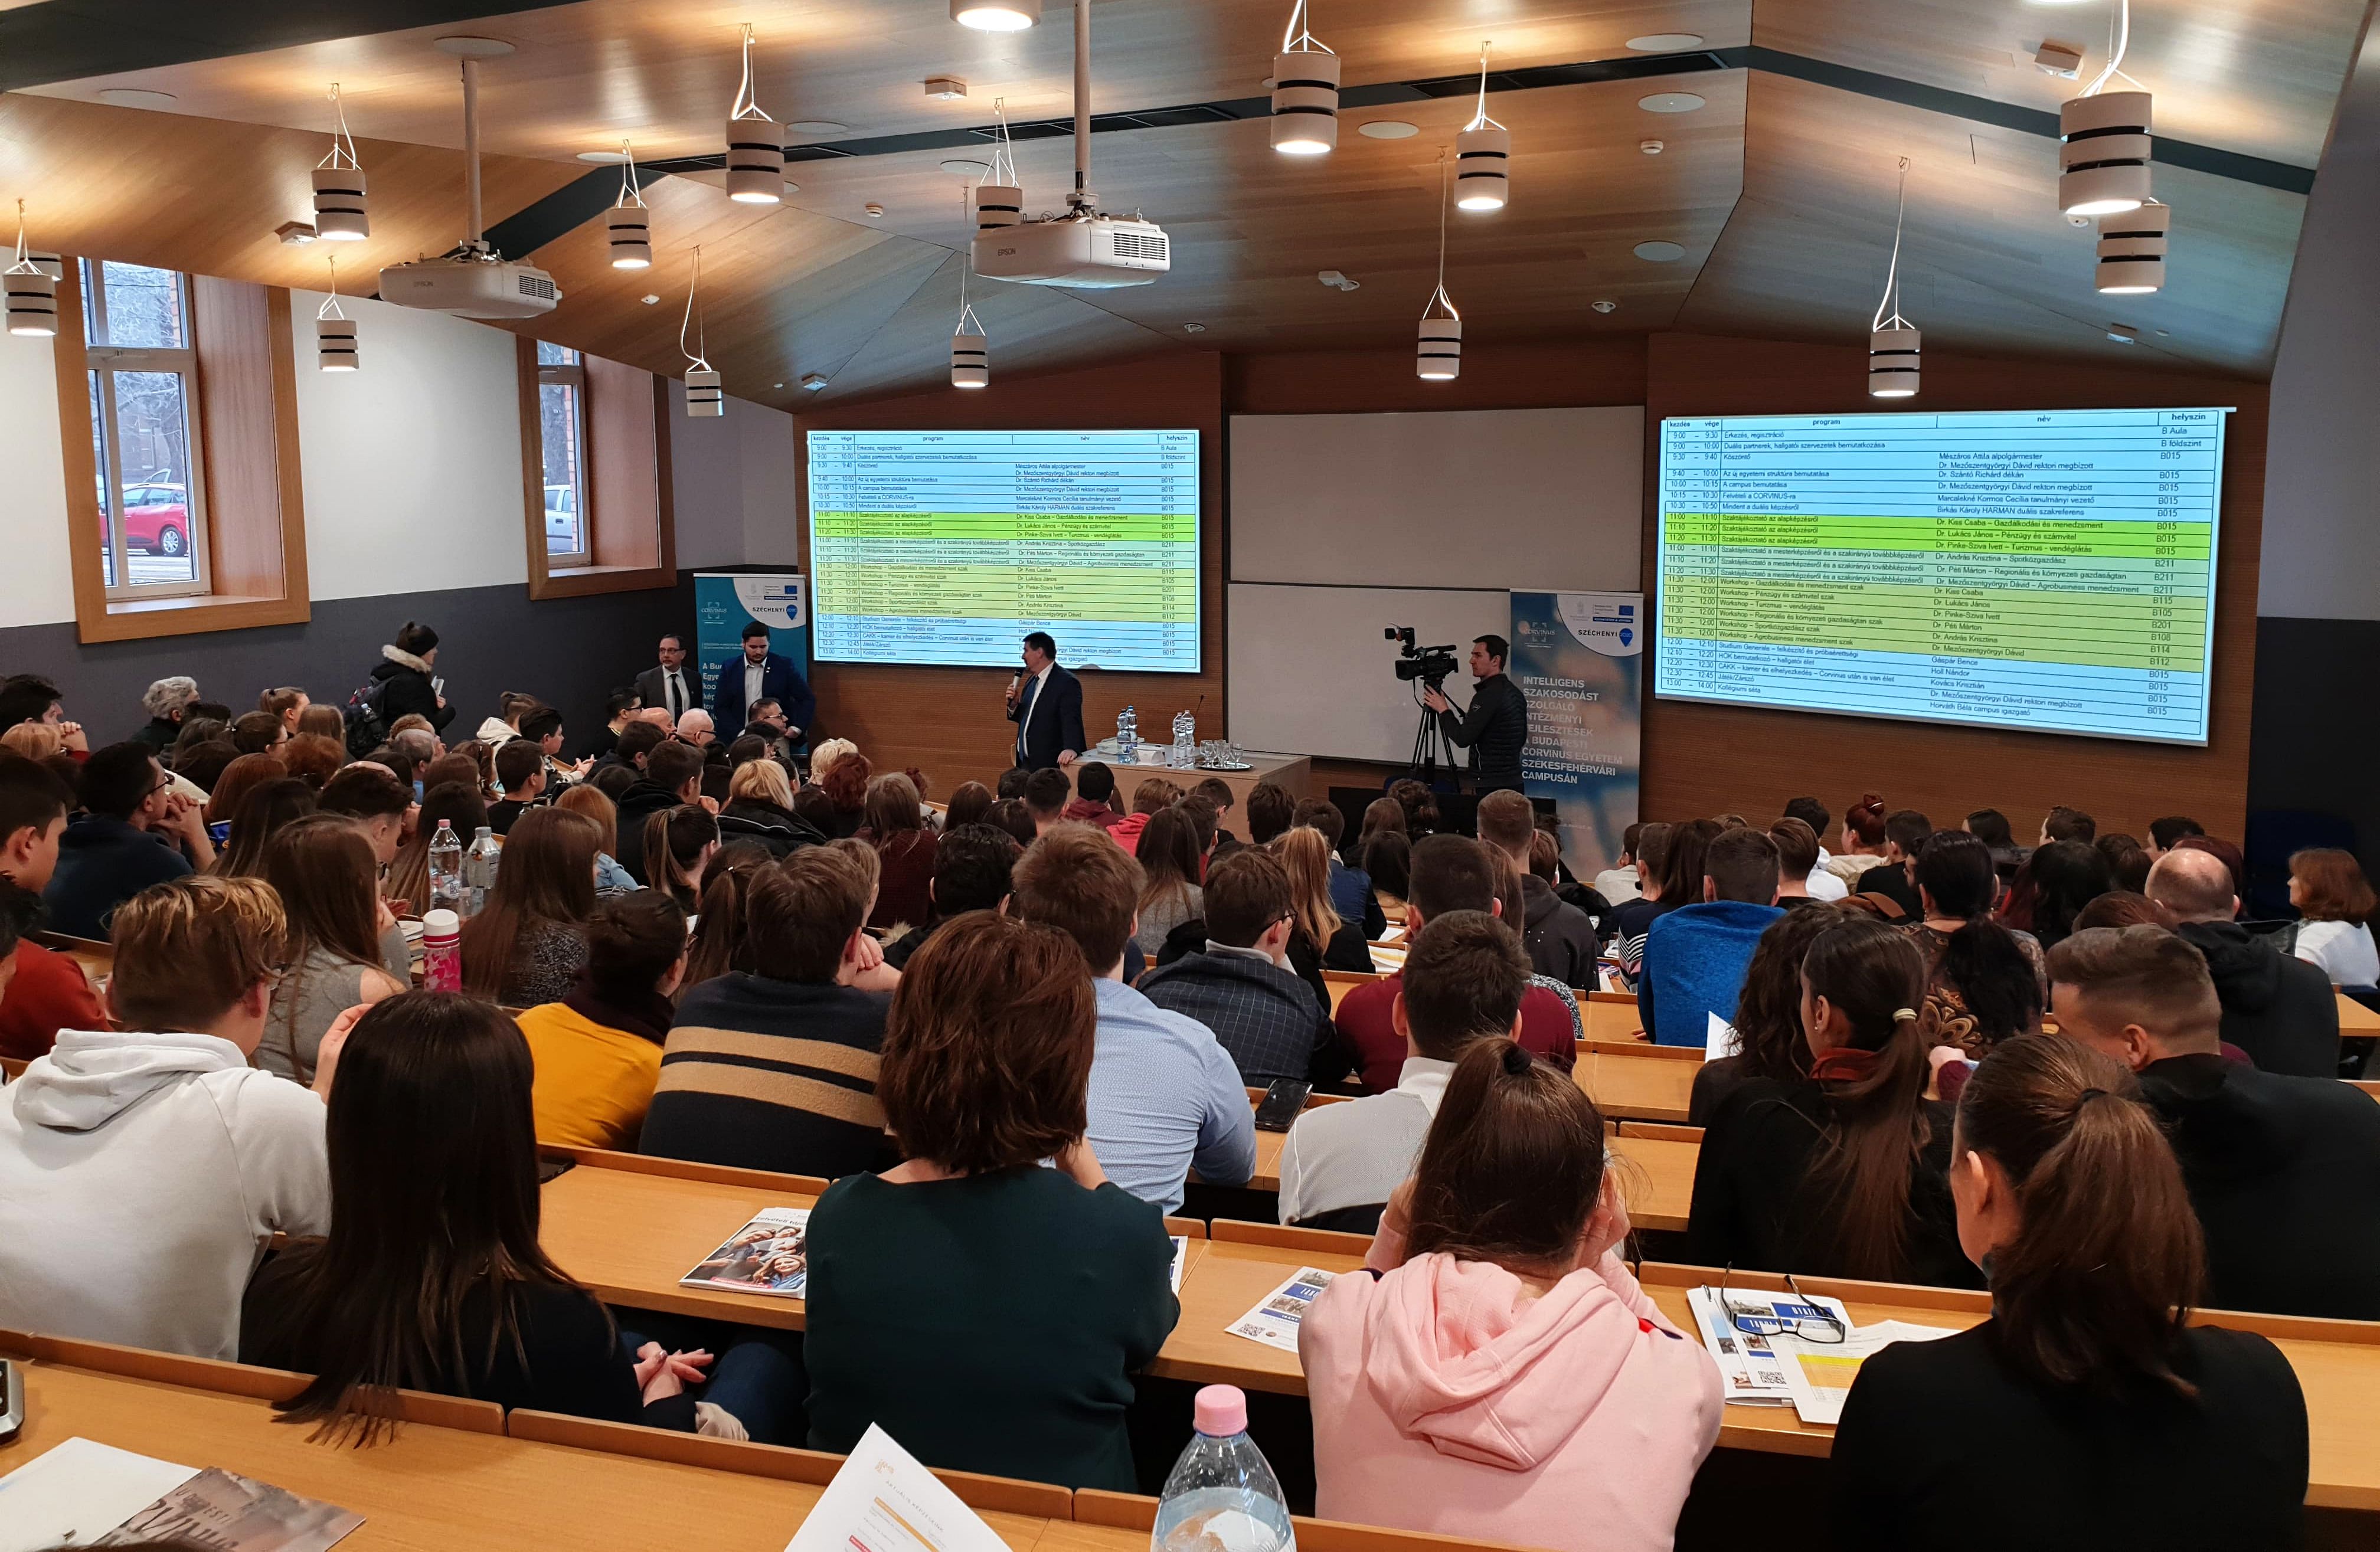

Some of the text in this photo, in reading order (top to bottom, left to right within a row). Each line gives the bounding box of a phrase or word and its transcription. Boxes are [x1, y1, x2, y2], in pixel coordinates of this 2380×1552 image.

[1777, 515, 1818, 523] alapképzésről
[1578, 628, 1617, 637] SZÉCHENYI
[1931, 656, 1955, 665] Gáspár
[1524, 676, 1585, 688] INTELLIGENS
[1524, 688, 1599, 701] SZAKOSODÁST
[1526, 712, 1582, 724] NTÉZMÉNYI
[1532, 736, 1587, 748] BUDAPESTI
[1522, 747, 1622, 764] CORVINUS EGYETEM
[1522, 759, 1616, 776] SZÉKESFEHÉRVÁRI
[1522, 771, 1578, 784] CAMPUSÁN
